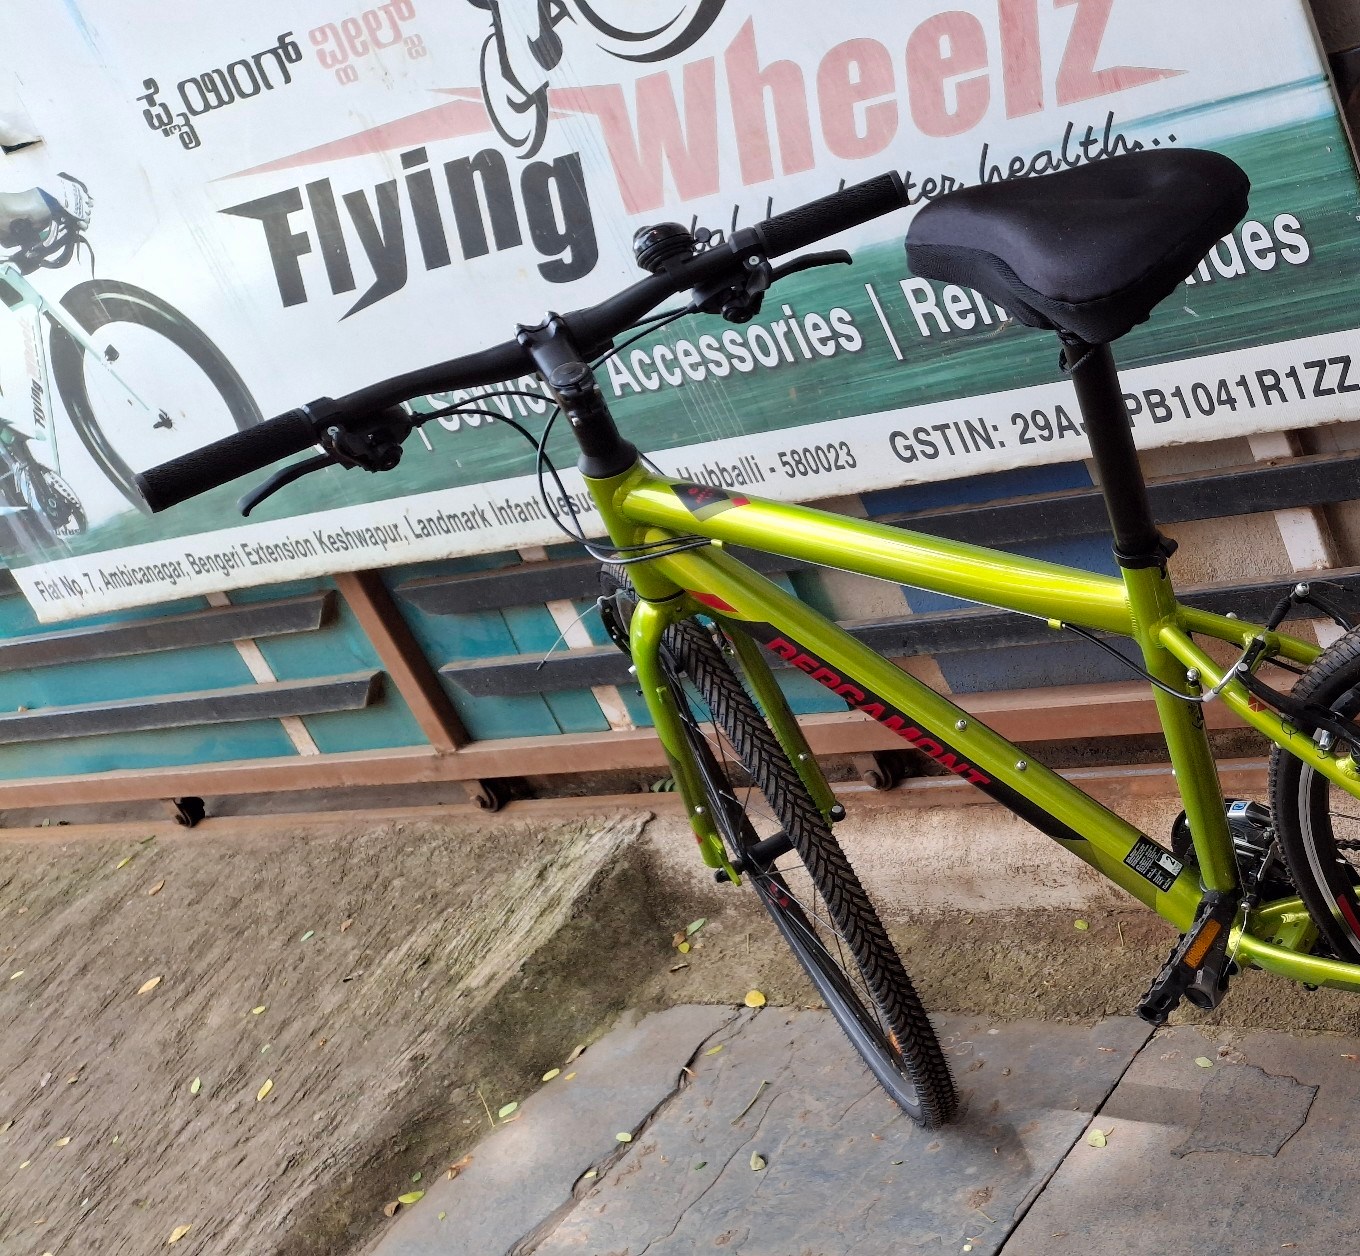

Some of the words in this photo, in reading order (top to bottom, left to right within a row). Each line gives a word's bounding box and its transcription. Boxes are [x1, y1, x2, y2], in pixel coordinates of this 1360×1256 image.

[217, 147, 599, 322] Flying
[425, 375, 558, 431] Servic
[604, 303, 864, 398] Accessories
[888, 421, 1005, 464] GSTIN:
[1010, 355, 1360, 446] 29APB1041R1ZZ
[33, 578, 62, 602] Flat
[99, 560, 191, 590] Ambicanagar,
[185, 545, 244, 577] Bengeri
[240, 534, 318, 566] Extension
[312, 521, 409, 553] Keshwapur,
[404, 504, 493, 540] Landmark
[487, 495, 547, 526] Infant
[676, 455, 766, 488] Hubballi
[777, 441, 857, 479] 580023
[764, 637, 992, 785] BERGAMONT
